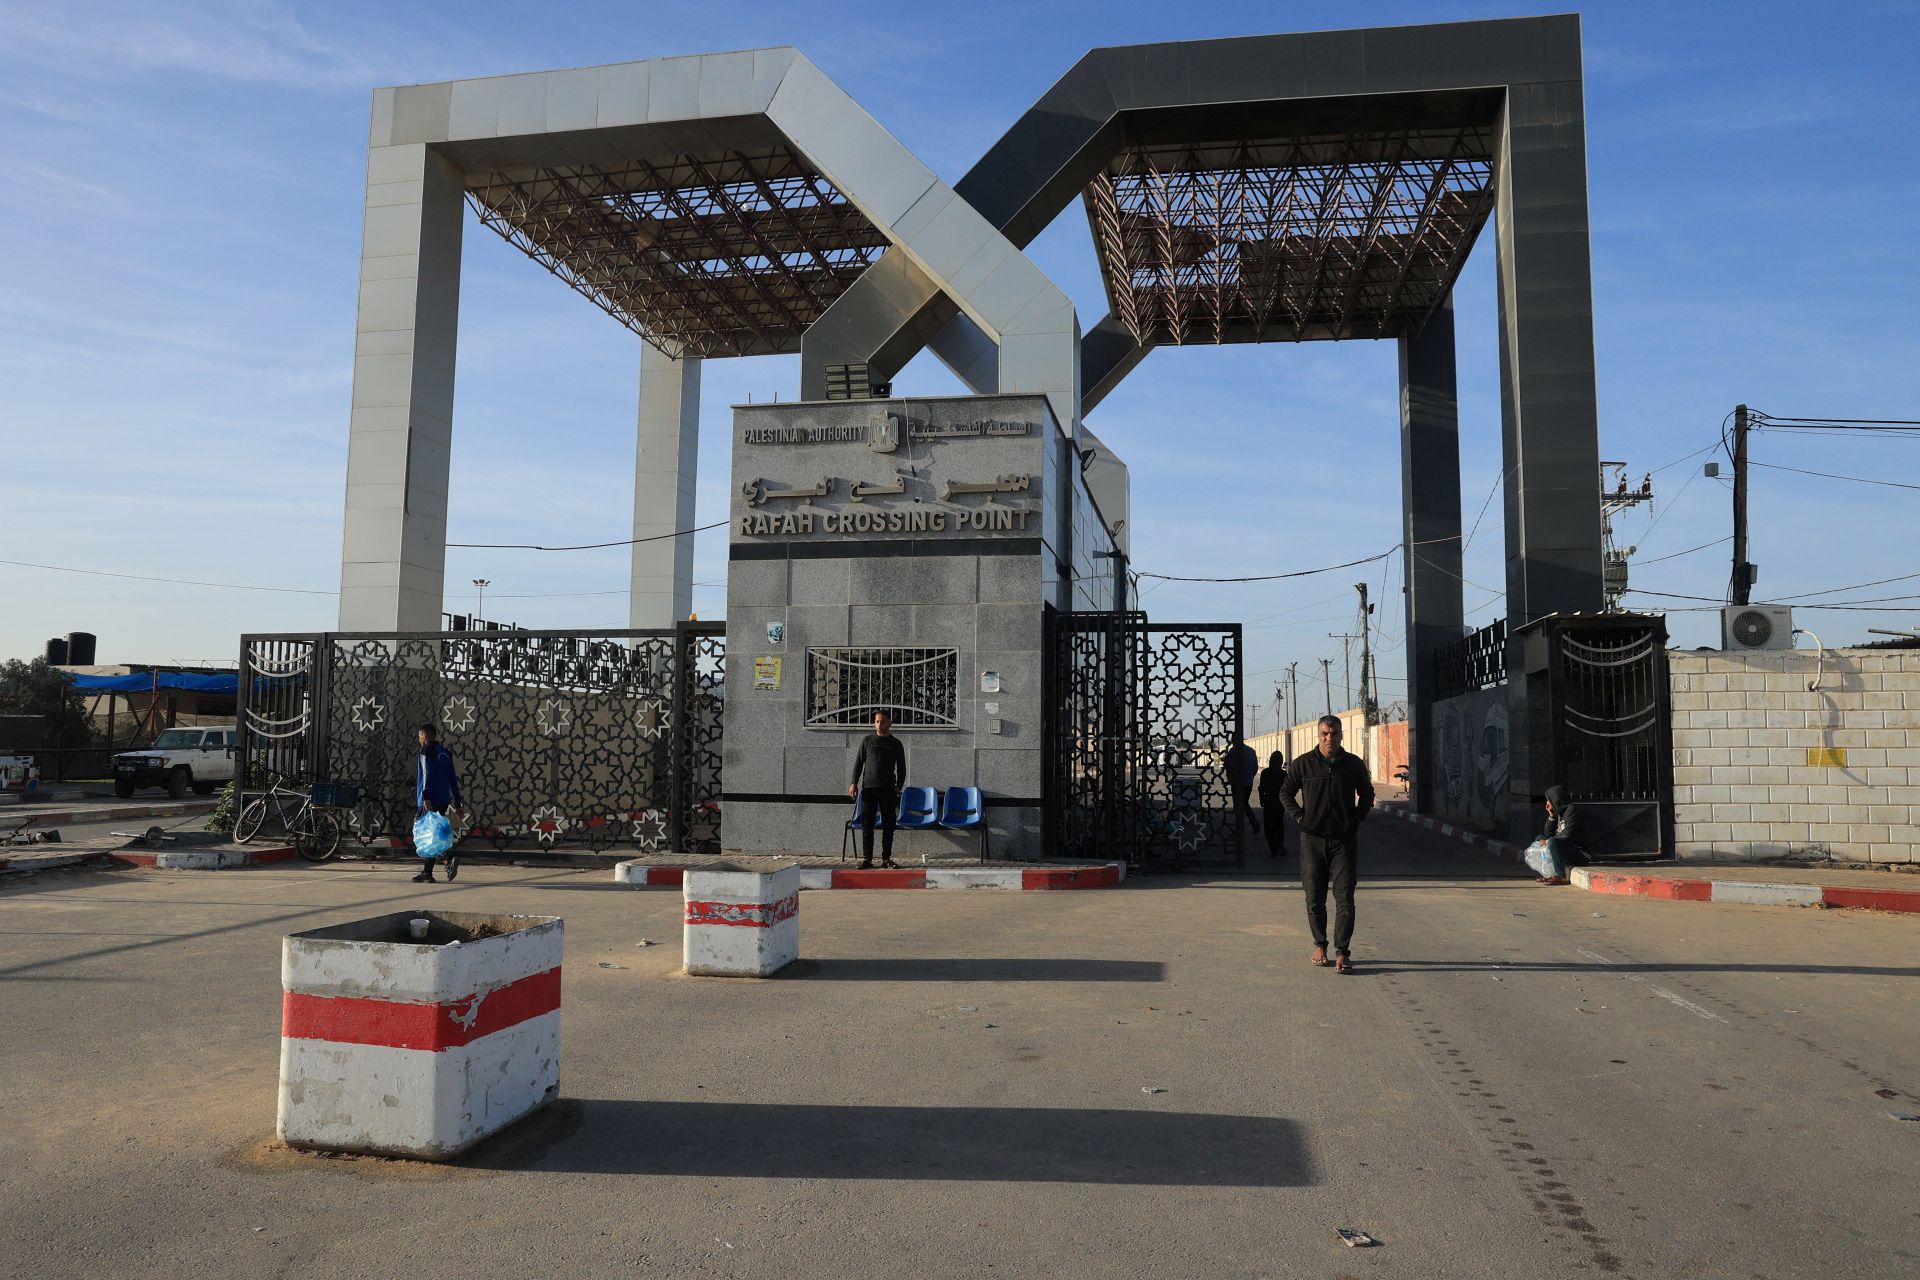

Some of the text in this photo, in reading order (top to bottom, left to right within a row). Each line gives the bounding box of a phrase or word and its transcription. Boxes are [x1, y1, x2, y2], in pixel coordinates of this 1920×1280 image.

[744, 425, 865, 443] PALESTINIAN AUTHORITY
[987, 419, 1031, 437] السلطة
[939, 472, 1030, 503] معبر
[740, 506, 1031, 535] RAFAH CROSSING POINT
